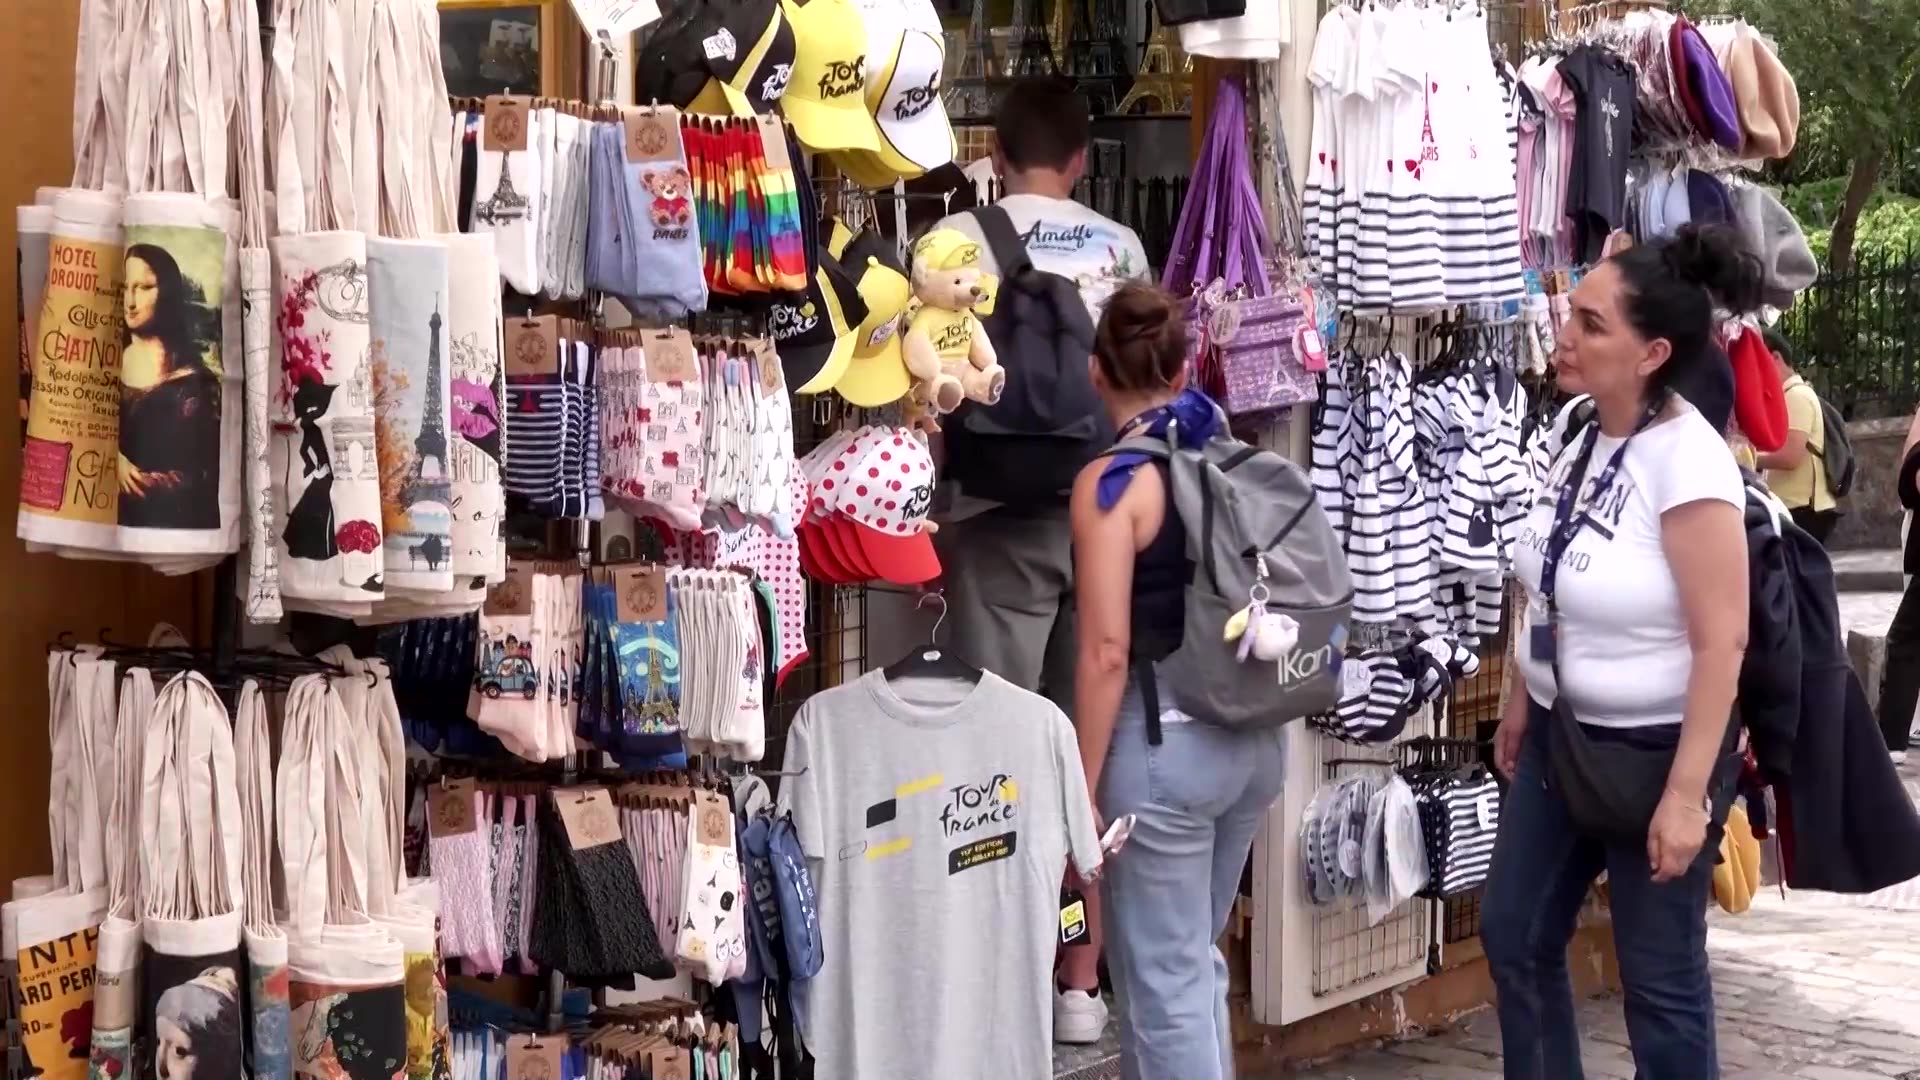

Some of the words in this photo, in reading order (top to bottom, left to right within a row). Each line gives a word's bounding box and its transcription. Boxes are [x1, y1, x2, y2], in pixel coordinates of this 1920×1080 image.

[1020, 219, 1094, 248] Amalfi
[54, 244, 98, 269] HOTEL
[51, 267, 99, 293] DROUOT
[43, 325, 90, 364] CHAT
[950, 774, 1009, 812] TOUR
[939, 802, 1016, 838] france
